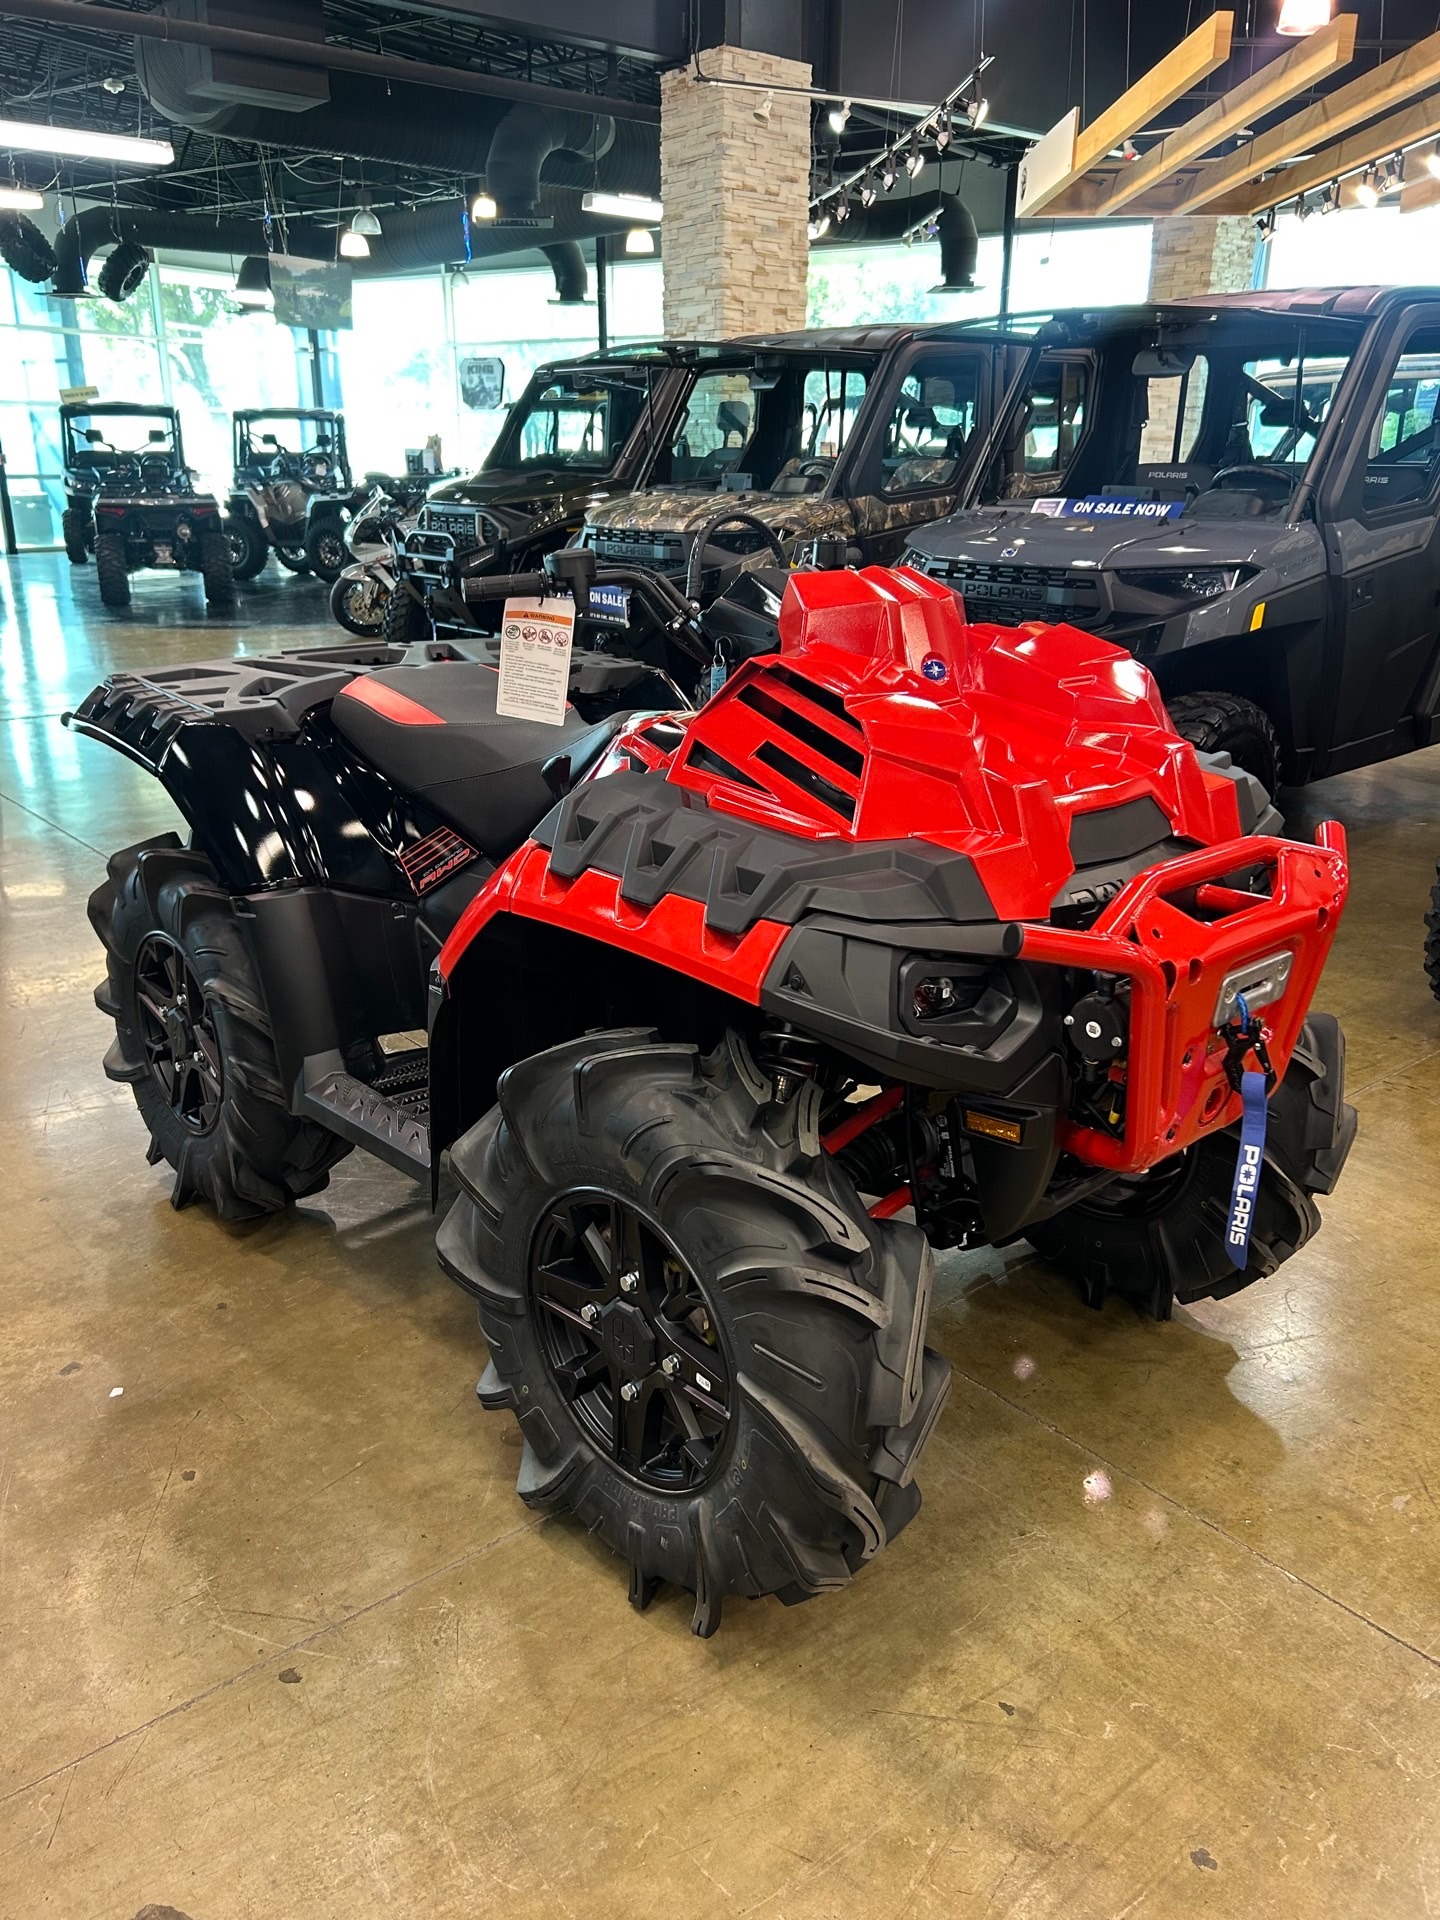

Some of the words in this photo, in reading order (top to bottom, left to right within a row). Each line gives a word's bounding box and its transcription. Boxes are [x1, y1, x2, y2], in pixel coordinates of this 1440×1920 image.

[1073, 502, 1095, 513] ON
[1094, 503, 1135, 515] SALE
[1133, 504, 1172, 517] NOW
[606, 543, 652, 556] POLARIS
[590, 591, 601, 603] ON
[602, 593, 622, 607] SALE
[964, 583, 1043, 600] POLARIS
[530, 613, 554, 621] WARNING
[1229, 1145, 1260, 1245] POLARIS
